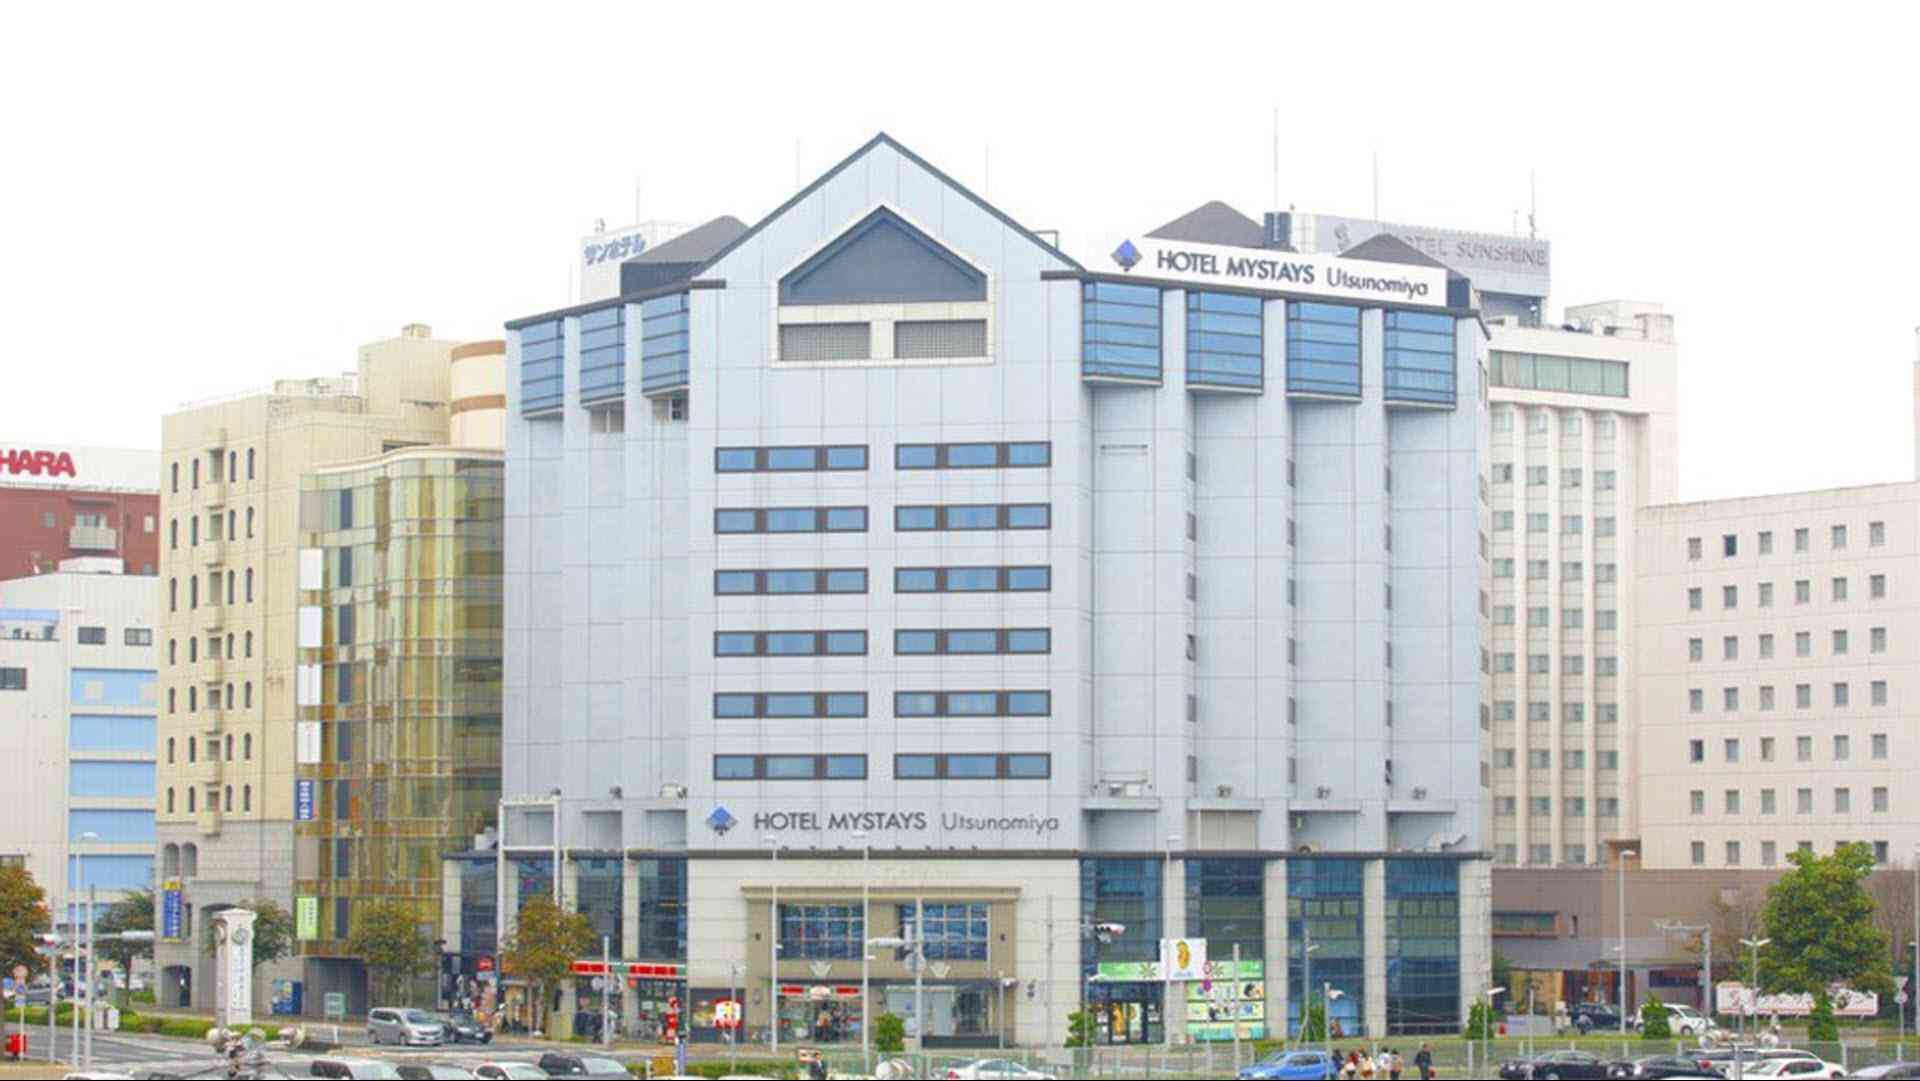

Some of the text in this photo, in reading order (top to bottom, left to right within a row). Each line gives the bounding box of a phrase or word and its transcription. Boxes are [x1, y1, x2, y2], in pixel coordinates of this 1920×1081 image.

[1456, 240, 1545, 266] SUNSHINE
[1157, 249, 1429, 299] HOTEL MYSTAYS Utsunomiya
[754, 812, 1060, 834] HOTEL MYSTAYS Utsunomiya
